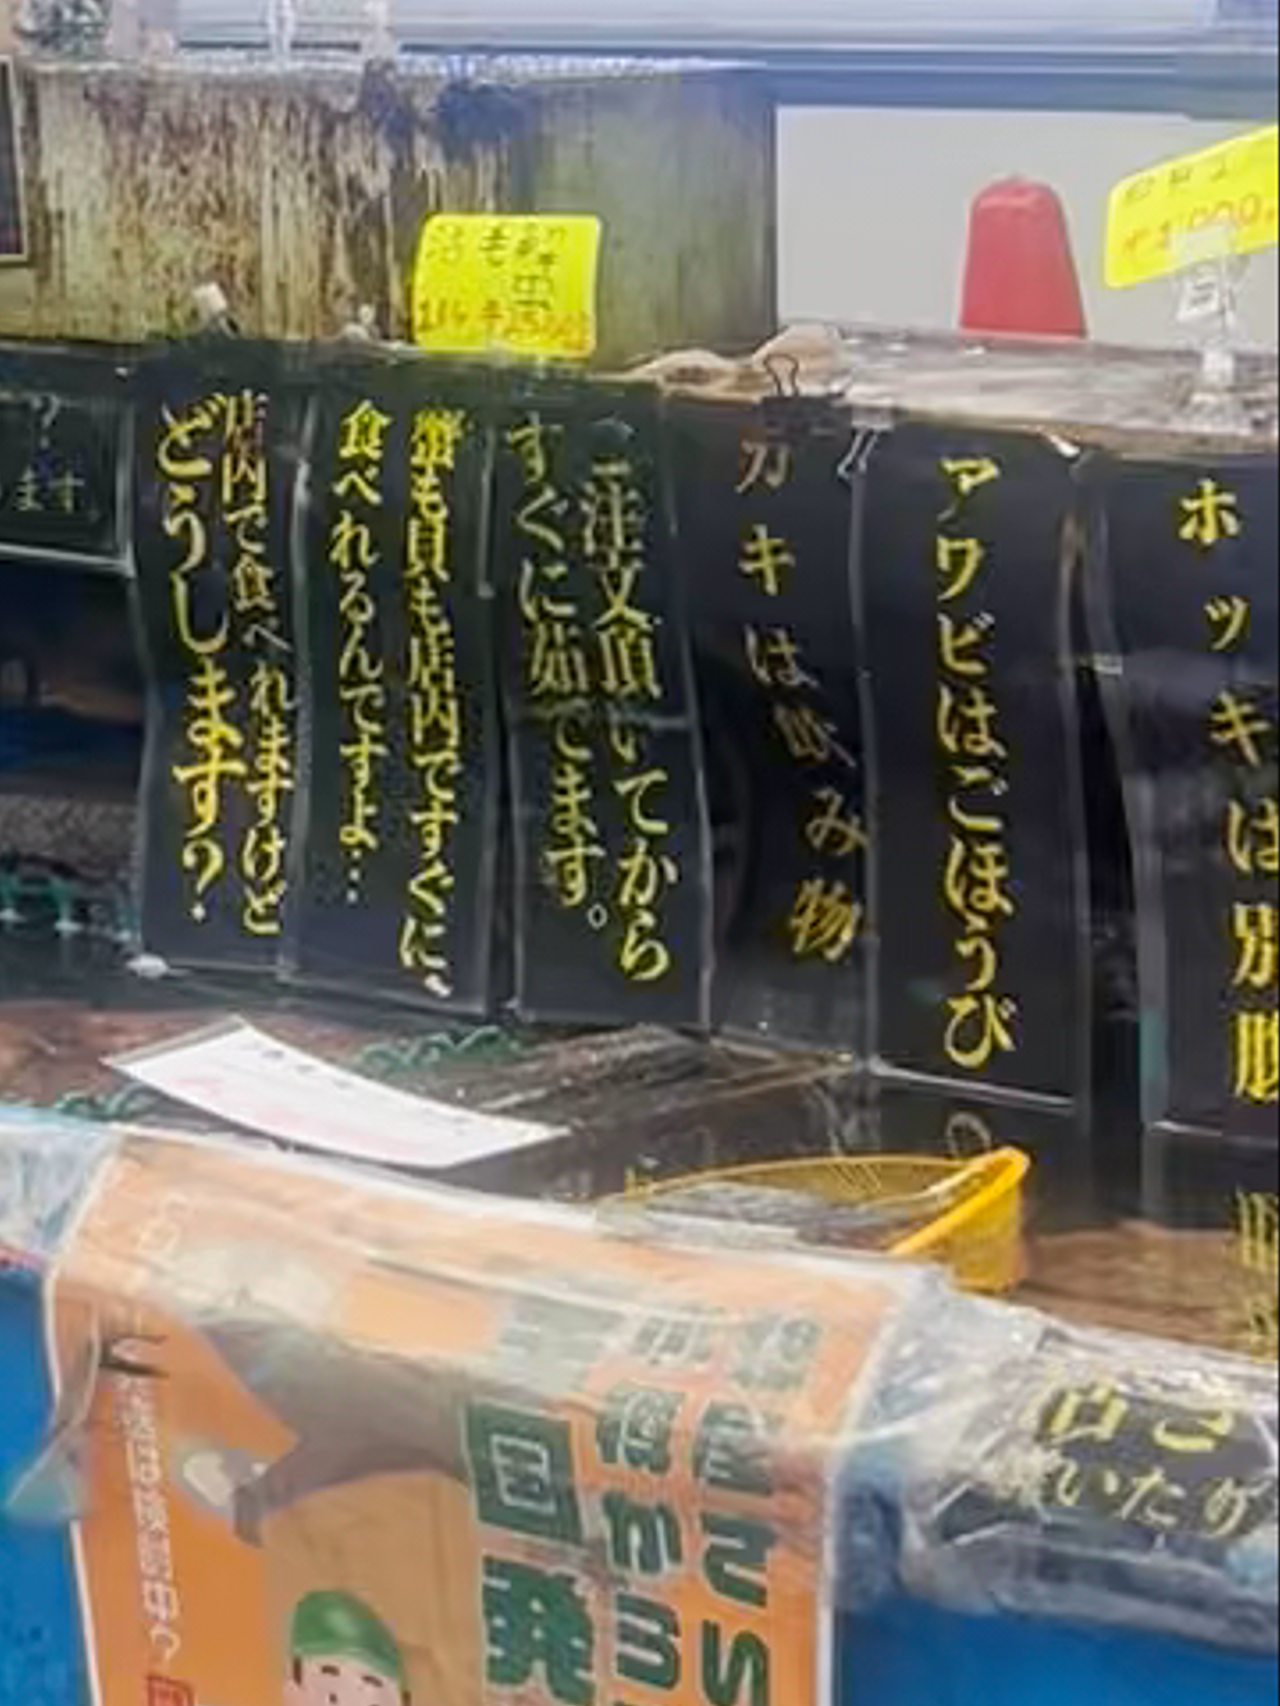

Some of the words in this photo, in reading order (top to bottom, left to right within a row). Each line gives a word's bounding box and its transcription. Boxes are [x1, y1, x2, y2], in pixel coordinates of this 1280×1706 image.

[156, 392, 246, 924] どうします?
[221, 389, 294, 935] 店内で食べれますけど
[735, 437, 867, 963] カキは飲み物
[936, 454, 1018, 1068] アワビはごほうび
